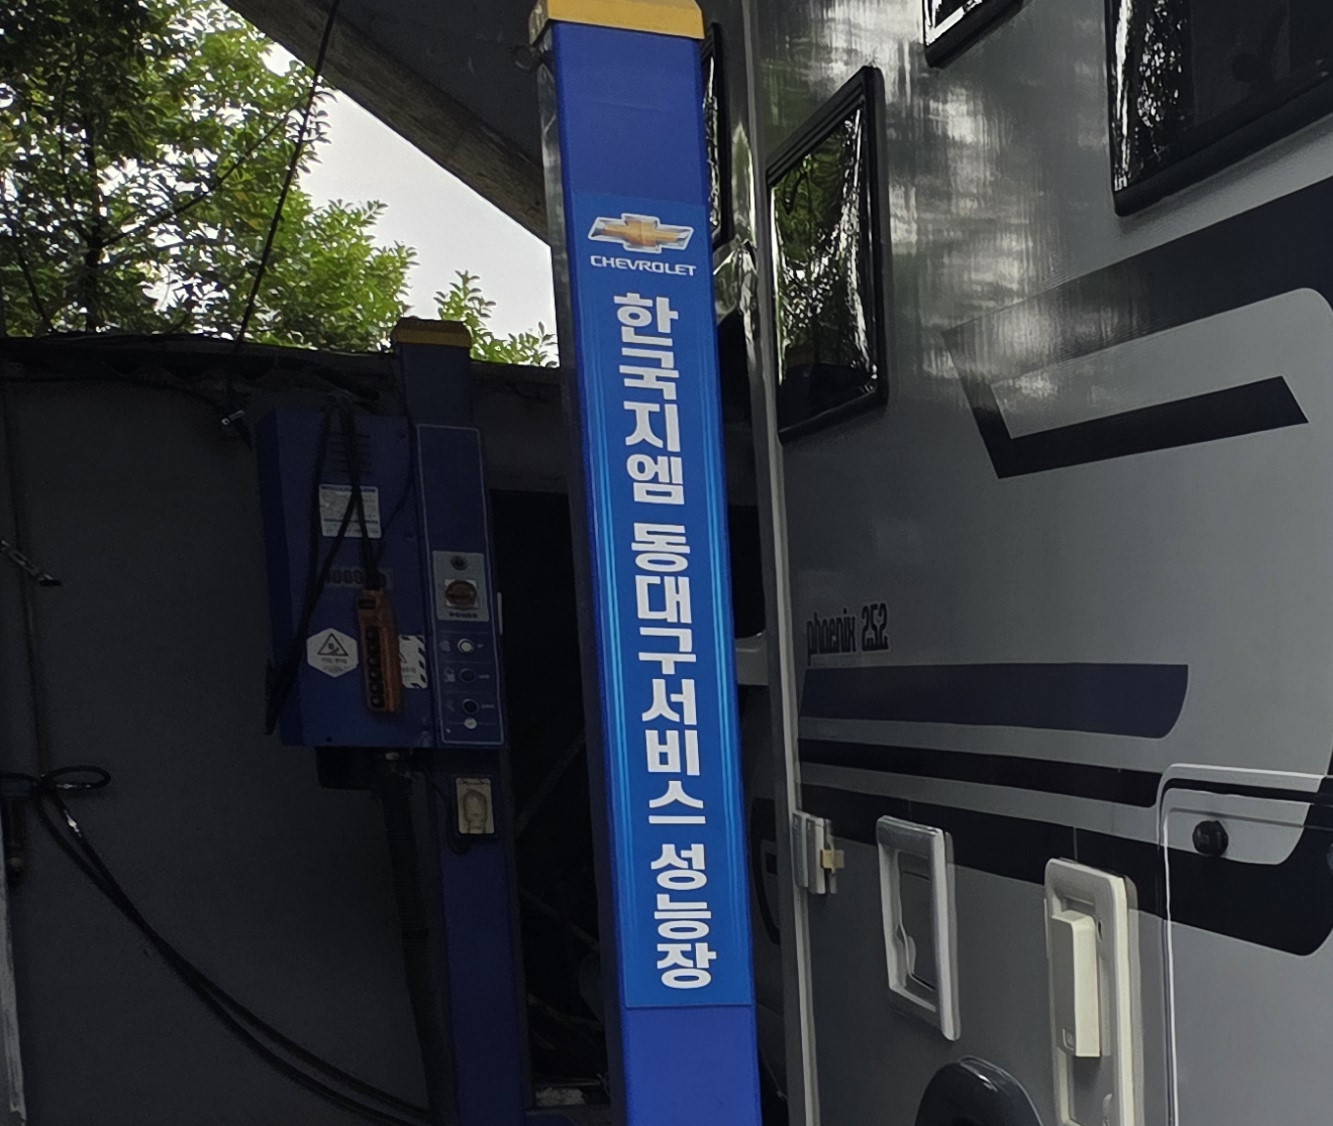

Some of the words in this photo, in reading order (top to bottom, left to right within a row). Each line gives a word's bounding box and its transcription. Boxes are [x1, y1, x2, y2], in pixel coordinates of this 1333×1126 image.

[590, 254, 697, 277] CHEVROLET
[613, 291, 685, 506] 한국지엠
[630, 522, 706, 825] 동대구서비스
[860, 602, 890, 652] 252
[650, 842, 718, 990] 성능장
